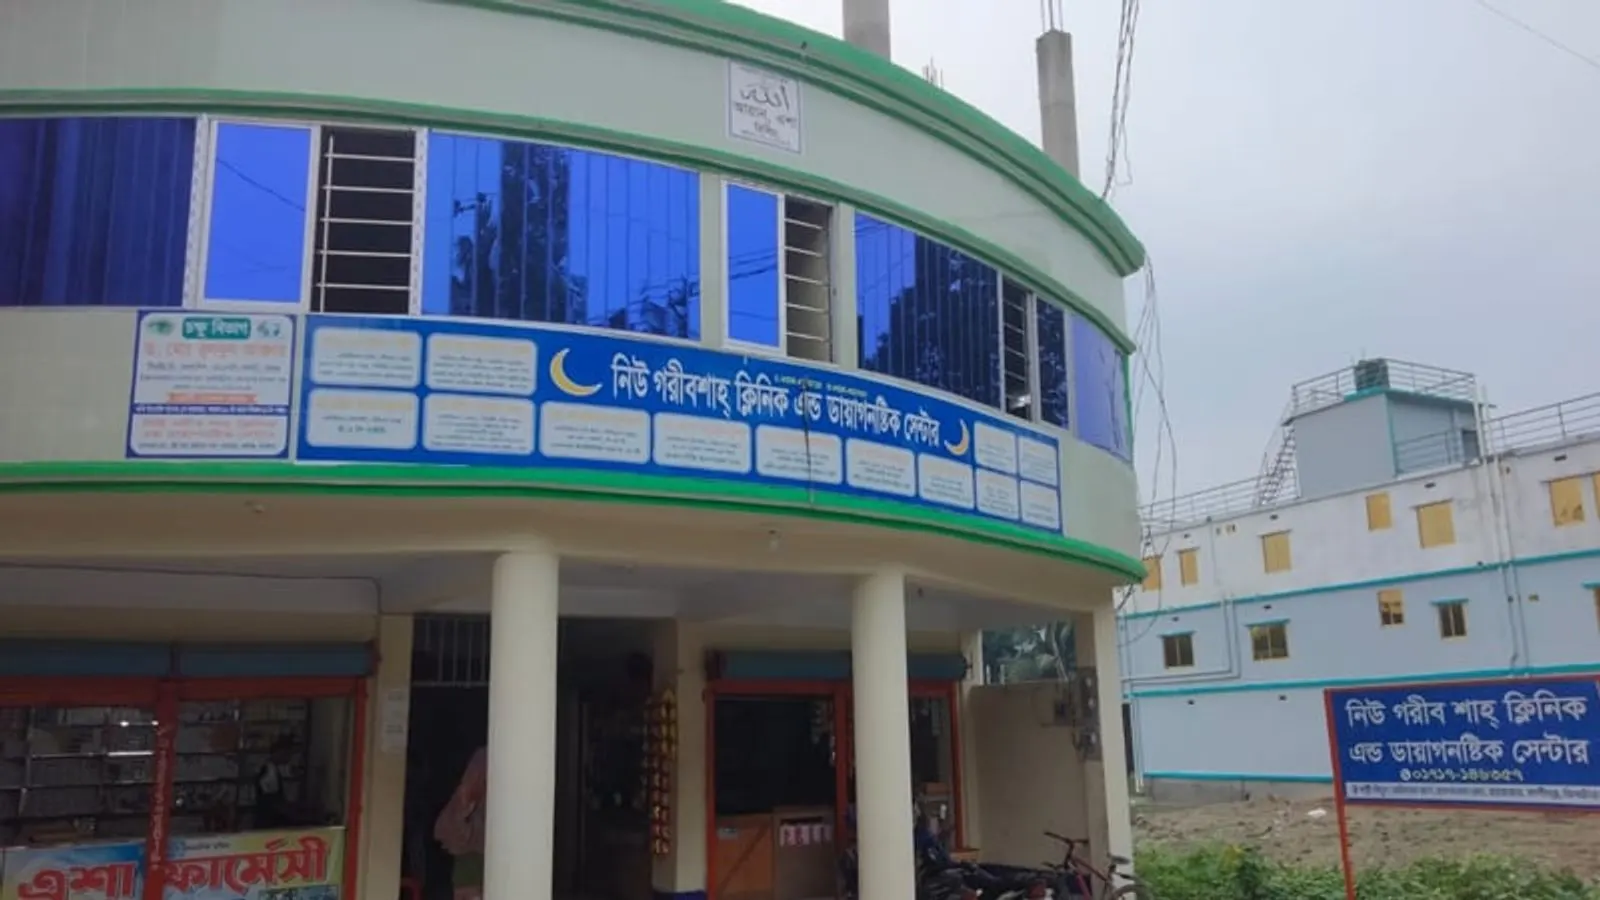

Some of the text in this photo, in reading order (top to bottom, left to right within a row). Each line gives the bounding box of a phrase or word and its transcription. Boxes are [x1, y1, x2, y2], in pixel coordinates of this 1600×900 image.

[610, 352, 651, 400] নিউ
[734, 370, 789, 417] ক্লিনিক
[904, 406, 940, 447] সেন্টার
[1345, 689, 1588, 730] নিউ গরীব শাহ্ ক্লিনিক
[1350, 742, 1383, 763] এন্ড
[1512, 730, 1589, 765] সেন্টার
[18, 835, 331, 900] এশা ফার্মেসী
